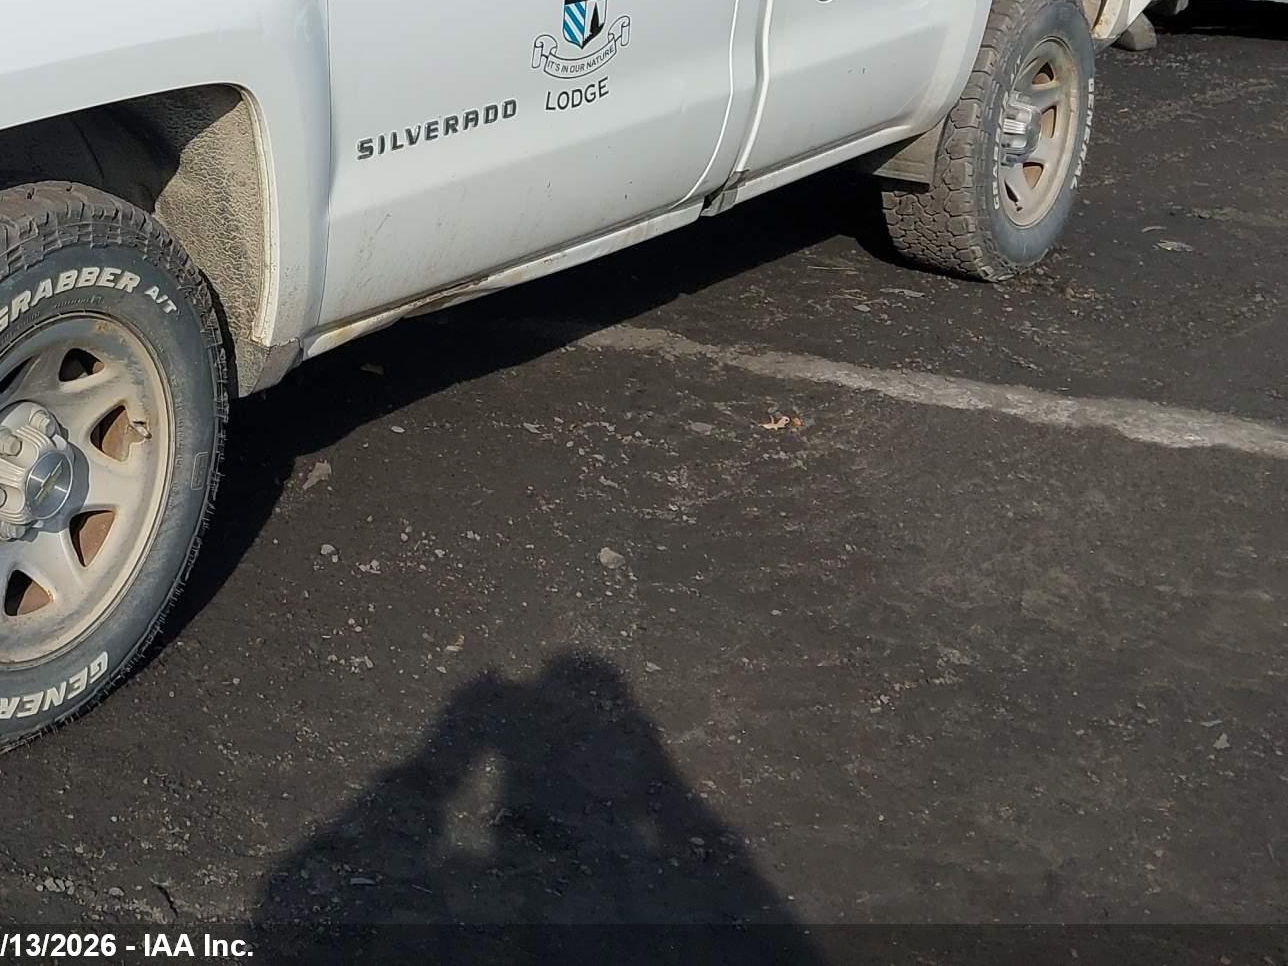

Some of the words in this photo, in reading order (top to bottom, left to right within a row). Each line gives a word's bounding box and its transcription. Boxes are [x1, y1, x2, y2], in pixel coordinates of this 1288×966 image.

[547, 60, 560, 71] IT'S
[561, 64, 569, 73] IN
[569, 63, 585, 74] OUR
[586, 44, 615, 68] NATURE
[545, 76, 610, 112] LODGE
[356, 98, 518, 161] SILVERADO
[1070, 78, 1094, 190] GENERAL
[144, 285, 178, 314] A/T
